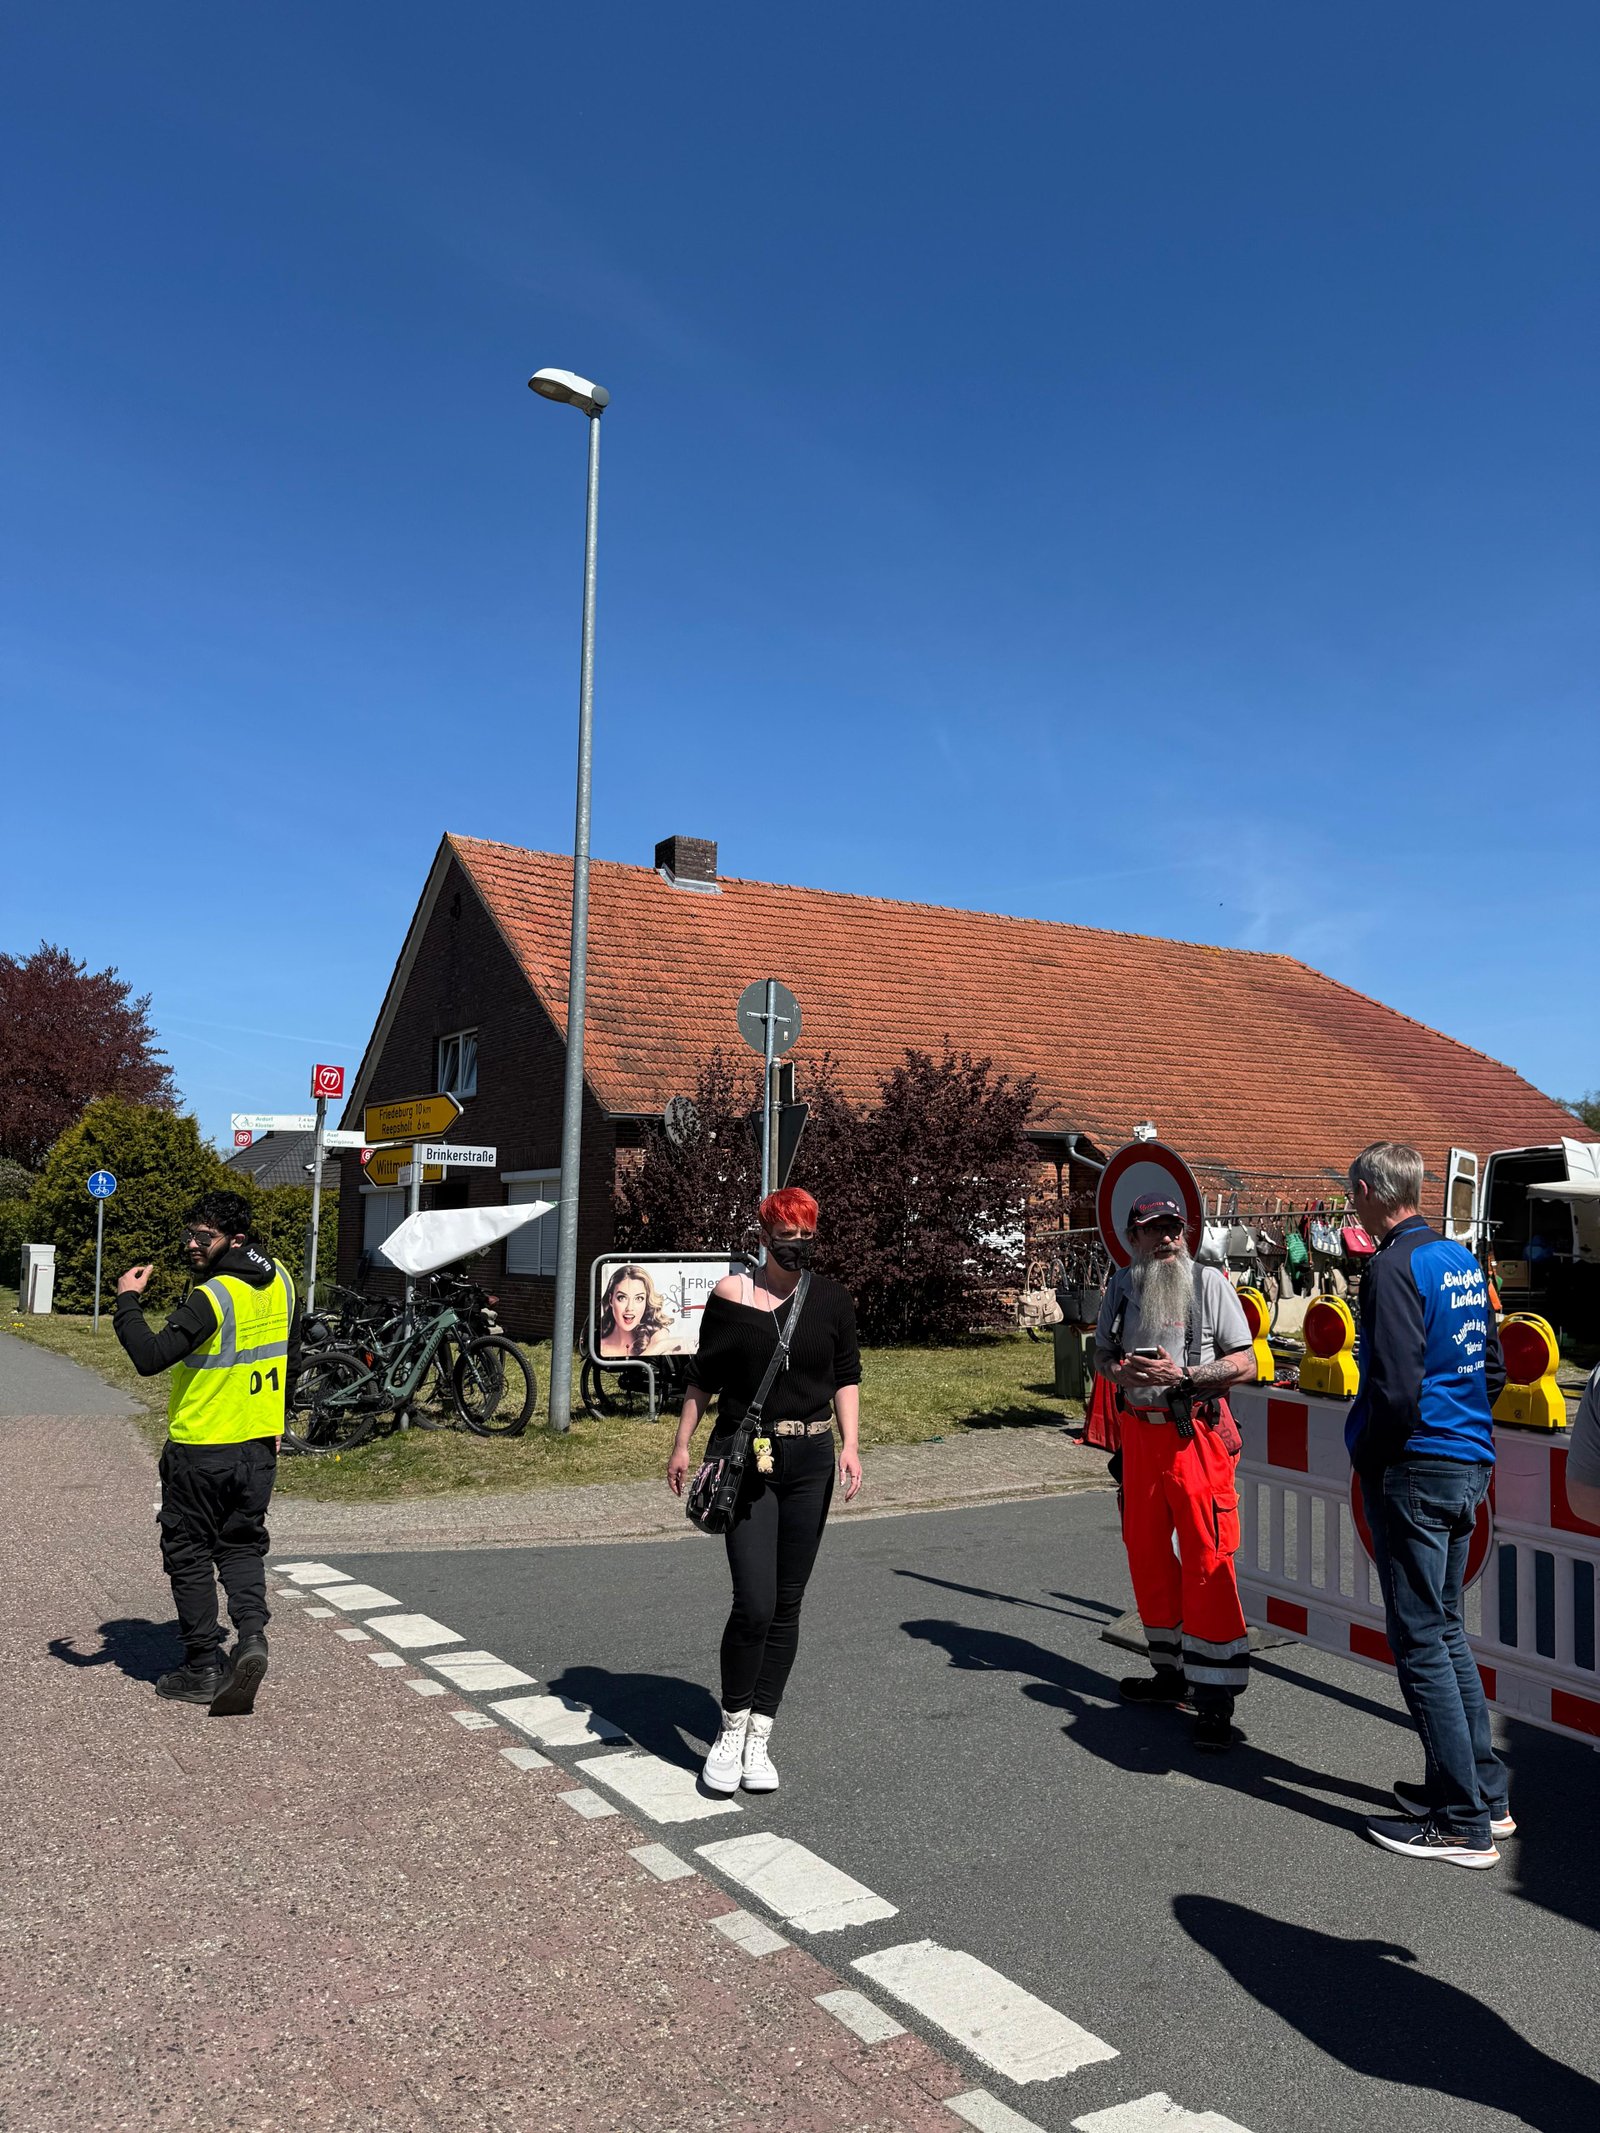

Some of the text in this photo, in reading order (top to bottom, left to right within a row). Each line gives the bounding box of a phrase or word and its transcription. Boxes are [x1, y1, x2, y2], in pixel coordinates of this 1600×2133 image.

[323, 1072, 337, 1085] 77
[380, 1103, 432, 1119] Friedeburg 10 km
[381, 1119, 431, 1136] Reepsholt 6 km
[238, 1134, 249, 1143] 89
[426, 1147, 494, 1163] Brinkerstraße
[376, 1159, 412, 1175] Wittmu
[246, 1248, 272, 1272] BLACK
[250, 1367, 279, 1396] 01
